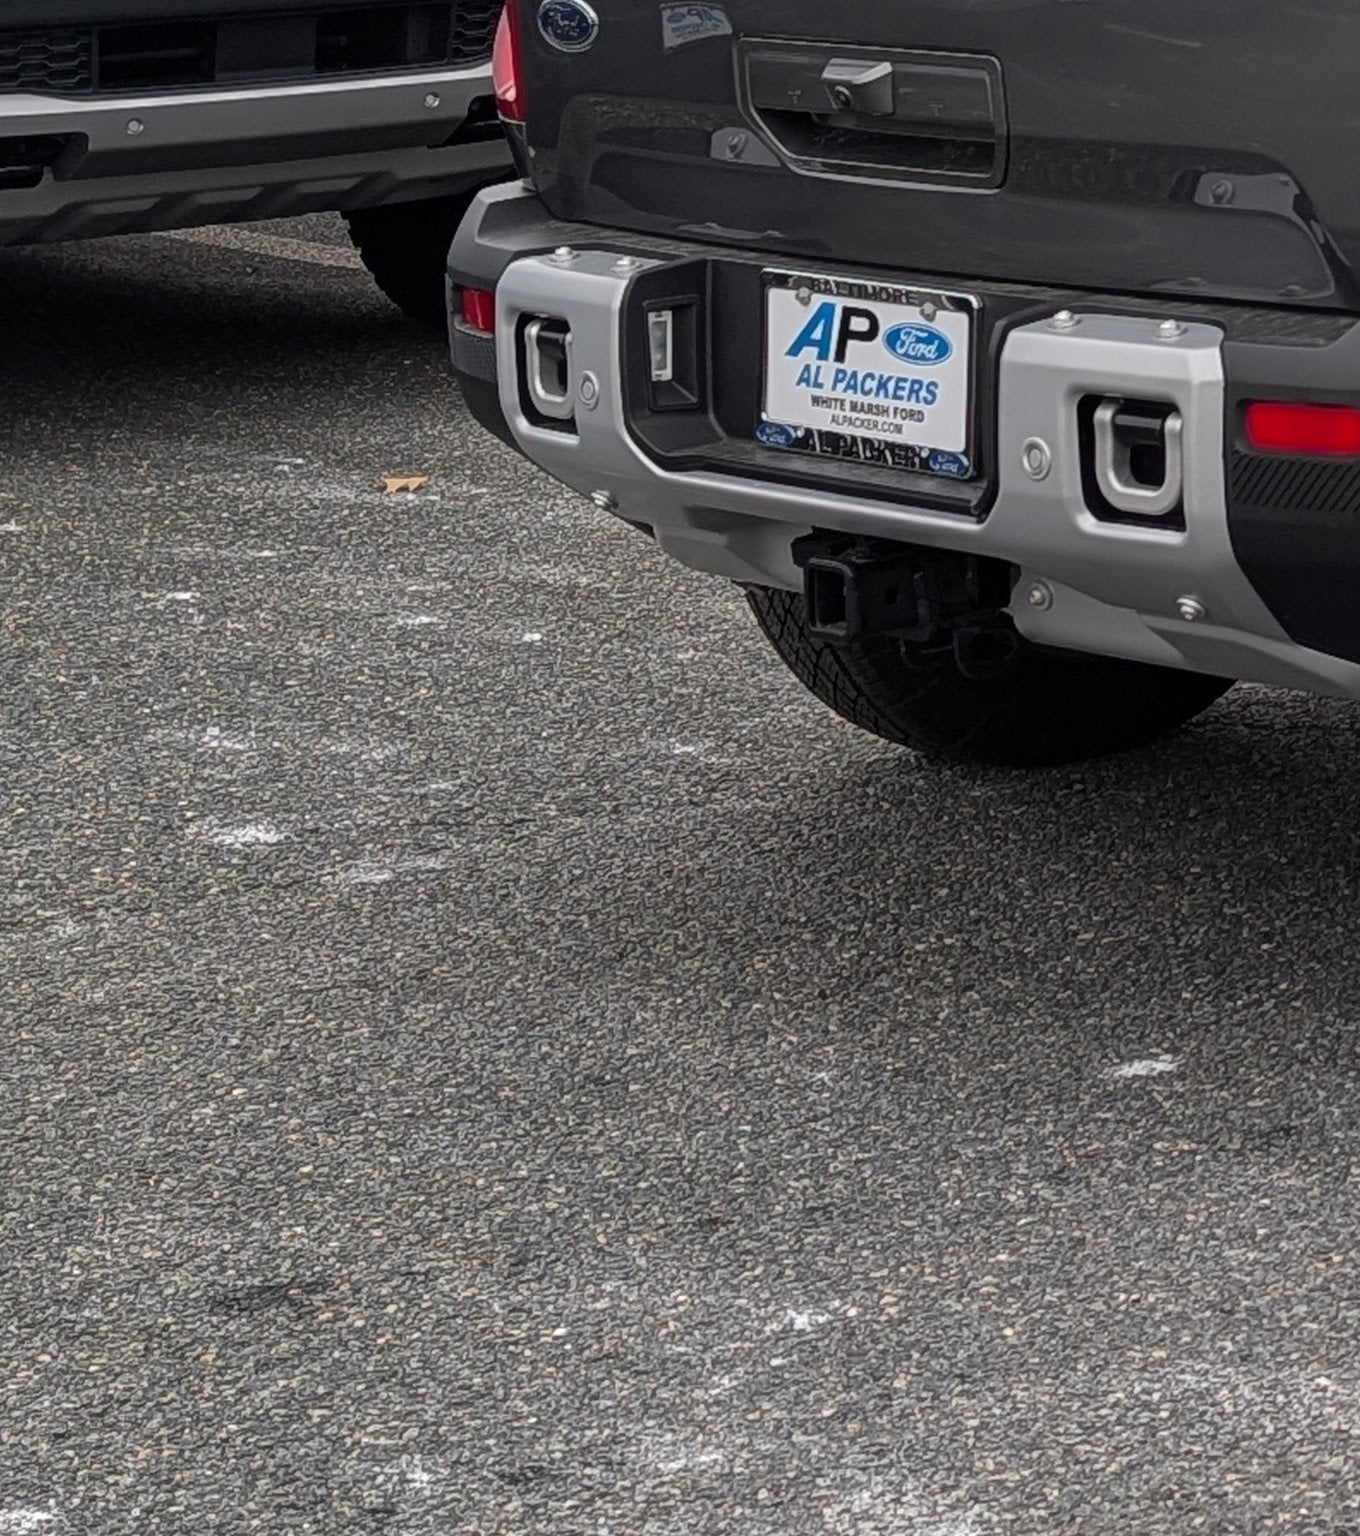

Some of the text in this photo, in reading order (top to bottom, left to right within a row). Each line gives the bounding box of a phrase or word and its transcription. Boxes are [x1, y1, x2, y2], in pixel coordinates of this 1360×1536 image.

[784, 301, 880, 364] AP
[893, 327, 939, 360] Ford
[795, 363, 939, 406] AL PACKERS
[810, 394, 925, 423] WHITE MARSH FORD
[829, 414, 904, 435] ALPACKER.COM
